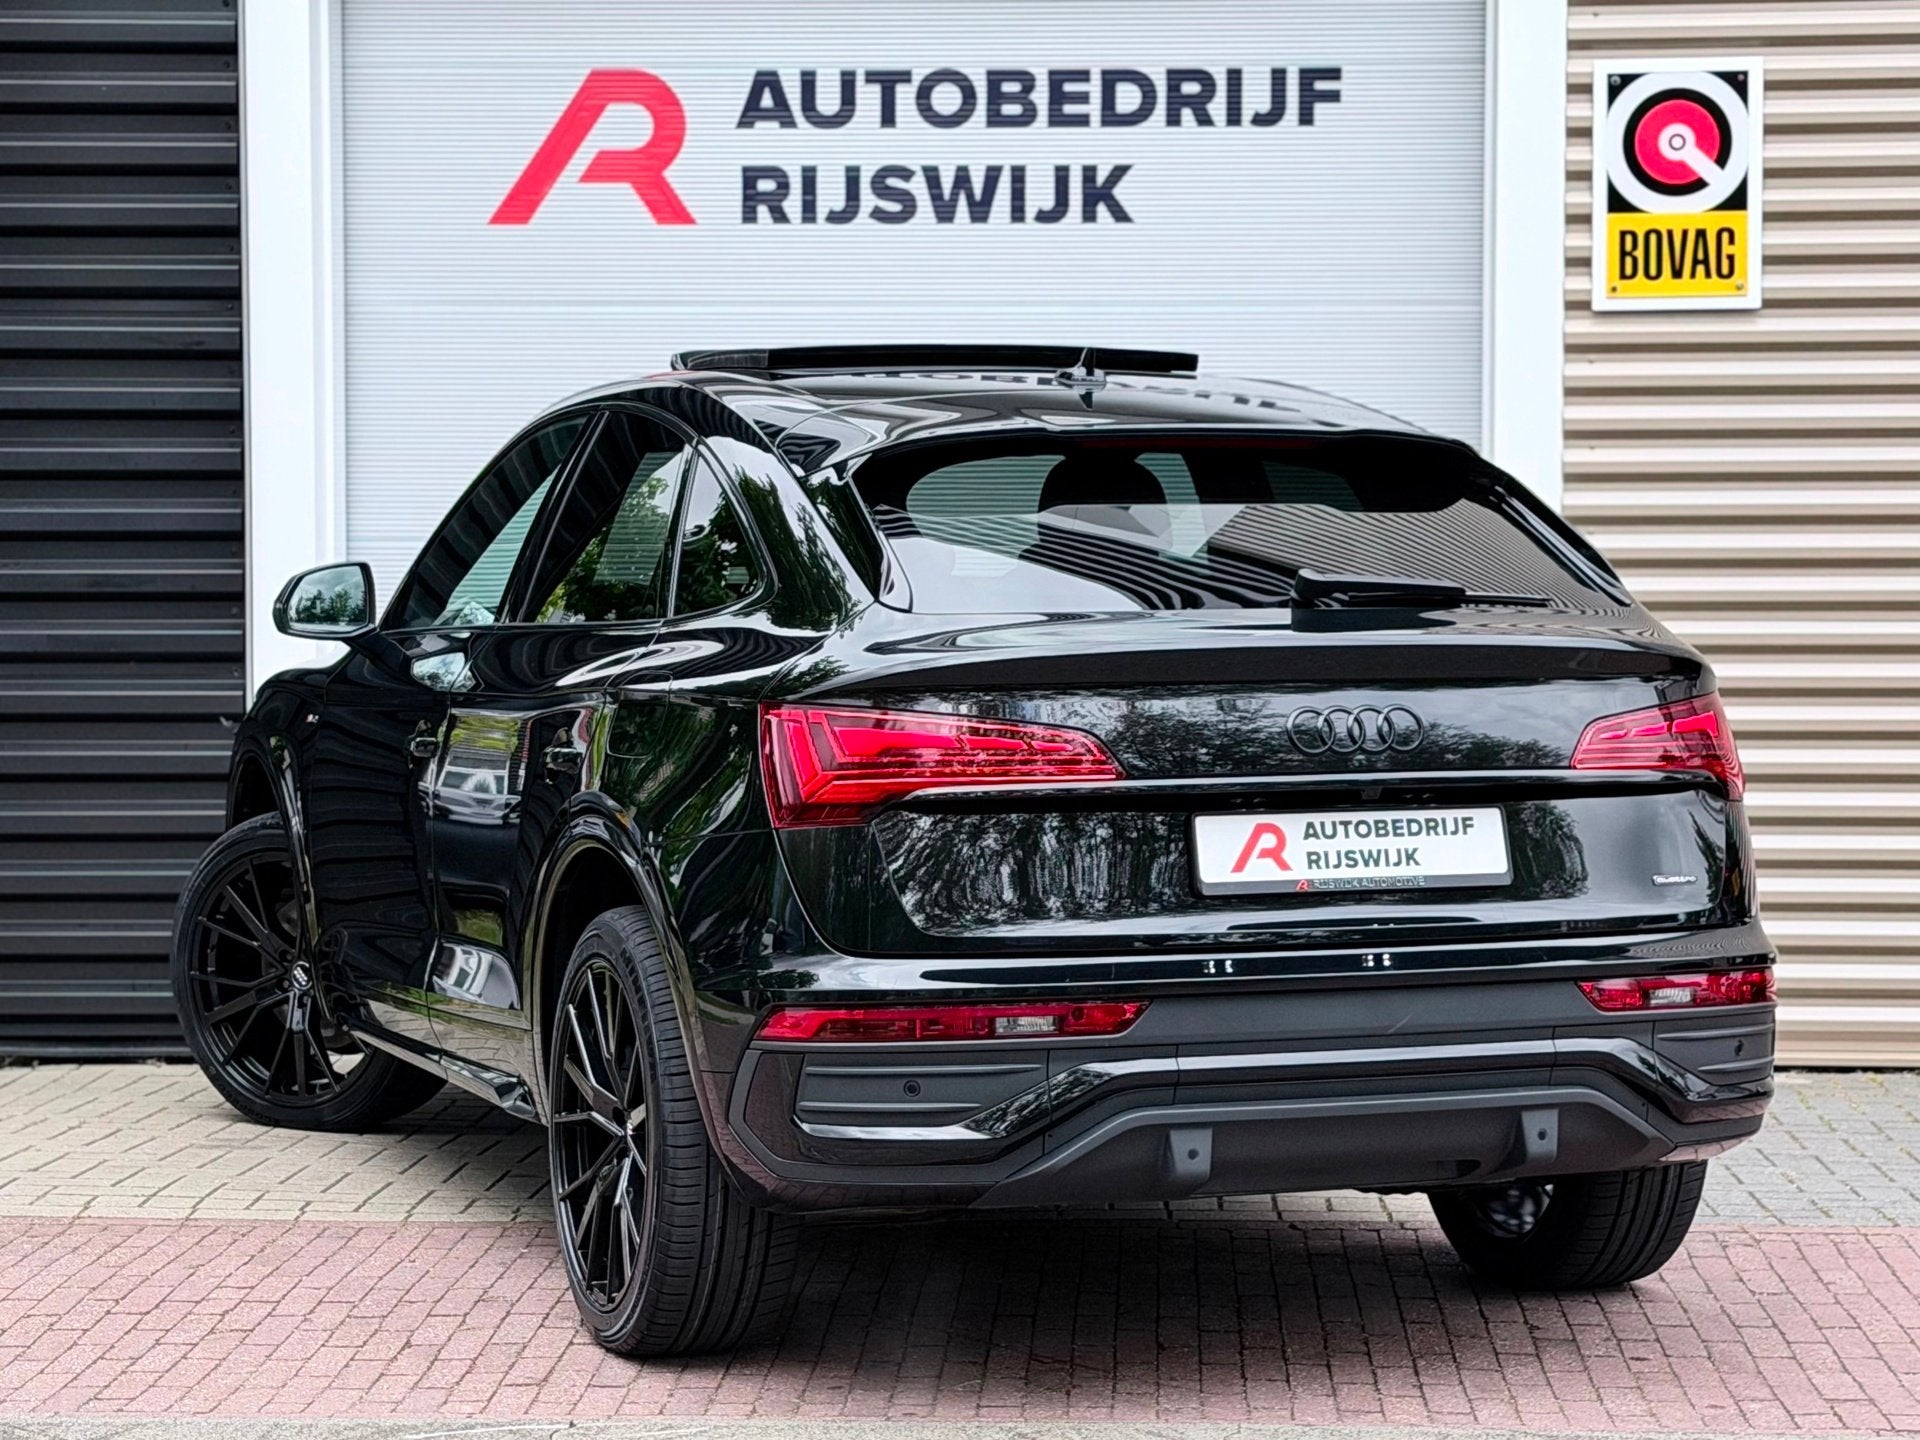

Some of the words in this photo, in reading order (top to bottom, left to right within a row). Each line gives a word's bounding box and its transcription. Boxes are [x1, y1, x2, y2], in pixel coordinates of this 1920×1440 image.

[735, 67, 1342, 129] AUTOBEDRIJF
[741, 164, 1134, 225] RIJSWIJK
[1618, 226, 1736, 281] BOVAG
[1302, 816, 1475, 841] AUTOBEDRIJF
[1305, 847, 1421, 870] RIJSWIJK
[1361, 875, 1426, 888] AUTOMOTIVE
